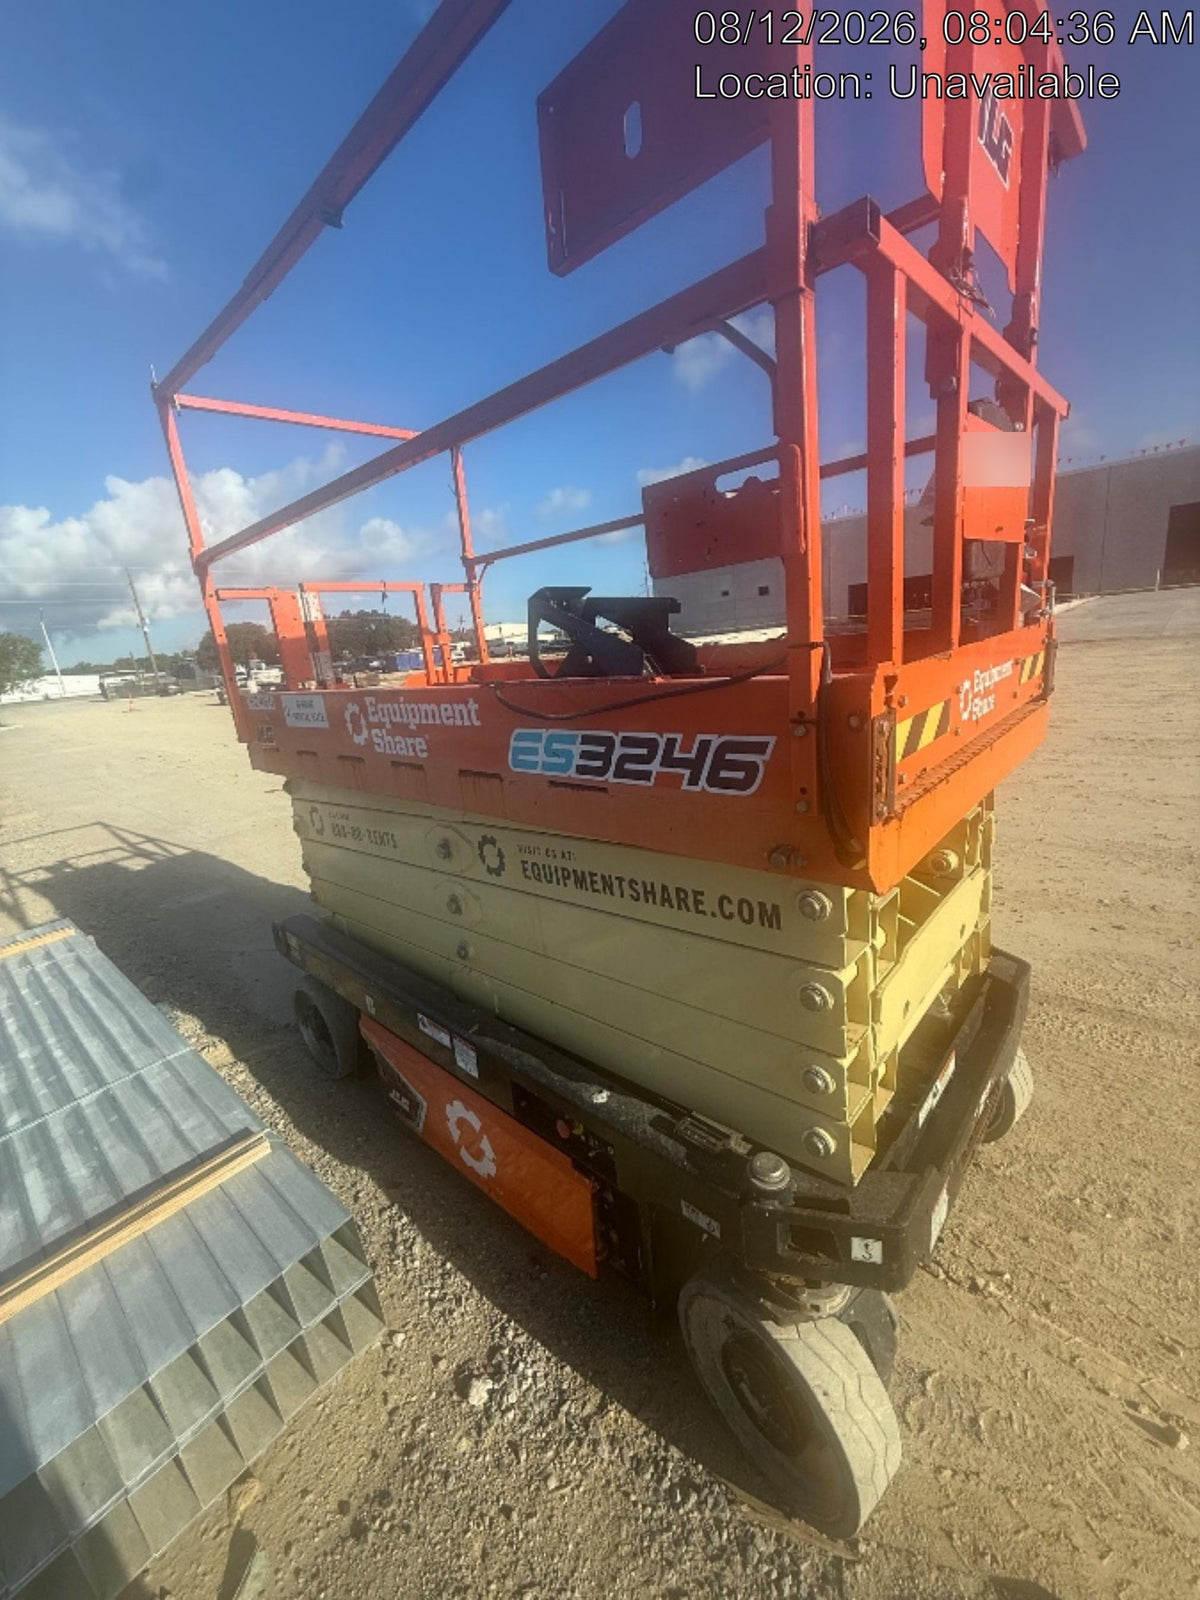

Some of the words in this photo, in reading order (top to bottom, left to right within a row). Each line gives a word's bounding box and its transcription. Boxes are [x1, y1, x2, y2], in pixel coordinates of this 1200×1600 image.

[363, 696, 482, 729] Equipment
[371, 727, 428, 758] Share
[508, 727, 778, 796] ES3246
[520, 858, 782, 930] EQUIPMENTSHARE.COM
